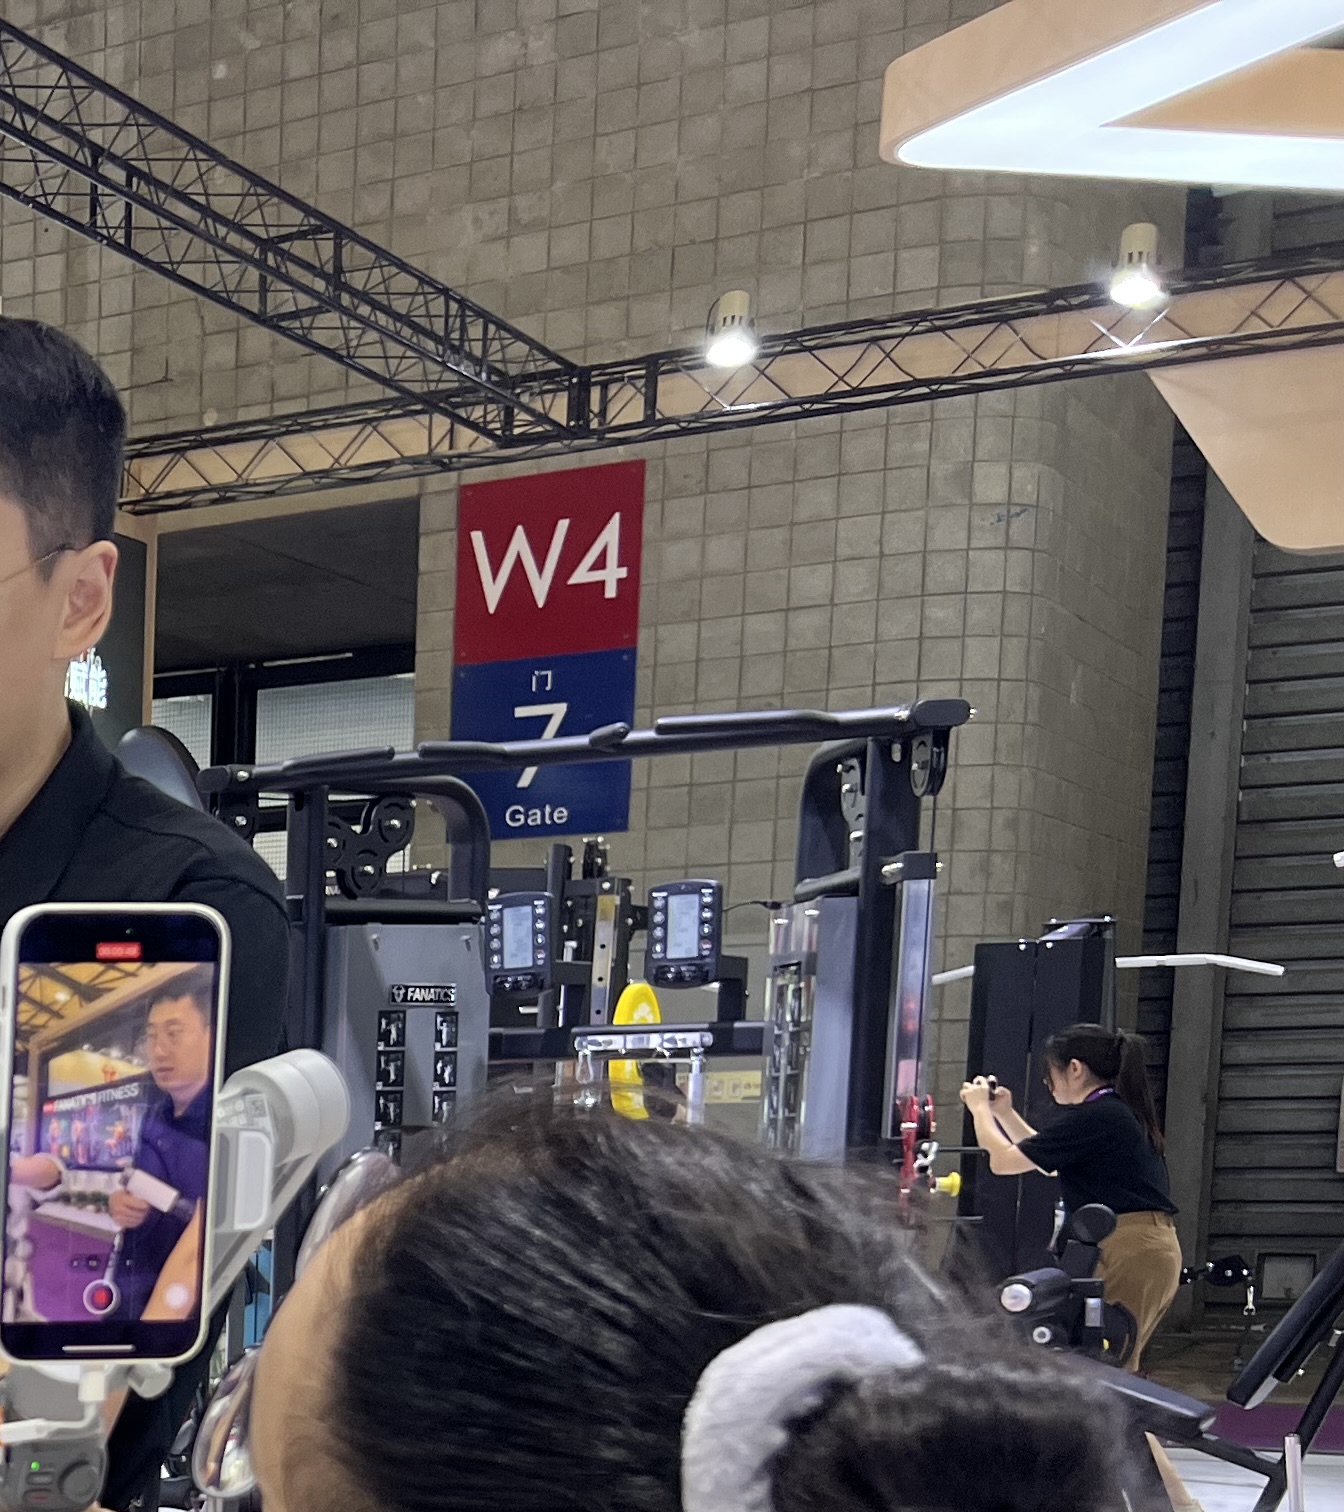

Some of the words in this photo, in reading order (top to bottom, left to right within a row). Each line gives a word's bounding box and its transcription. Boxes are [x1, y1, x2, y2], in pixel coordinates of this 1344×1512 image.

[470, 511, 628, 614] W4
[532, 670, 553, 692] 门
[514, 702, 568, 788] 7
[505, 804, 568, 828] Gate
[407, 988, 456, 1001] FANATICS
